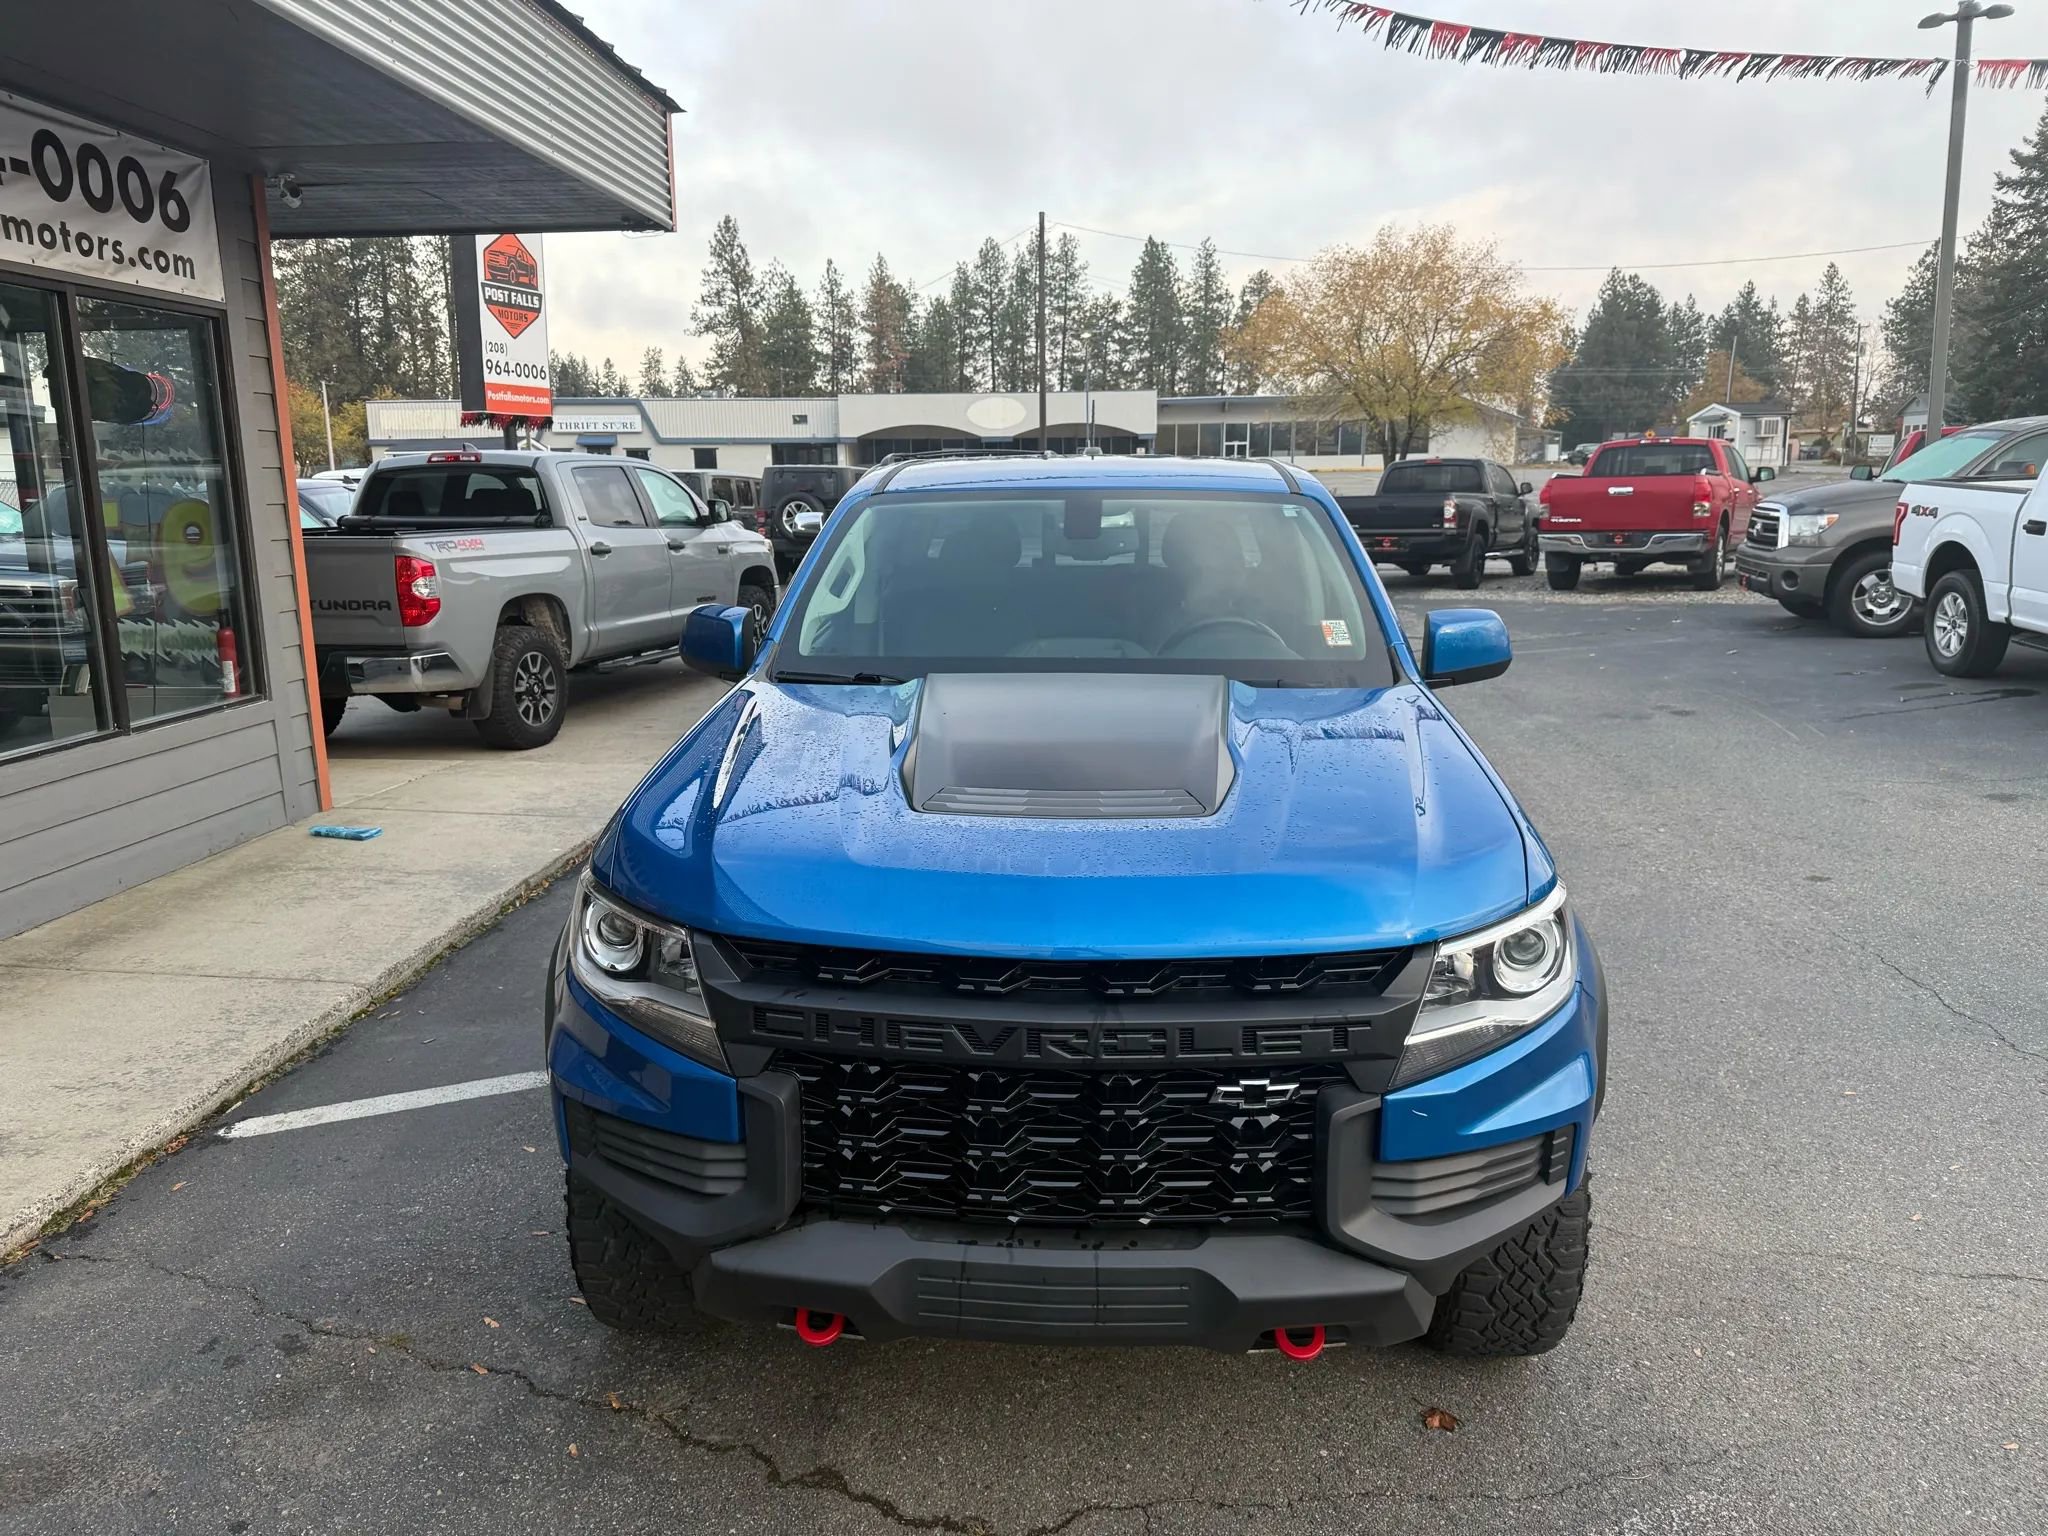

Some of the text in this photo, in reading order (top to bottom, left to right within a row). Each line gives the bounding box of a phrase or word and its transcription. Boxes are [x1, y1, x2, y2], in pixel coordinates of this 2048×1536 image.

[0, 128, 190, 233] -0006
[484, 286, 540, 308] POST FALLS
[498, 308, 529, 323] MOTORS
[485, 340, 508, 356] (208)
[485, 358, 547, 380] 964-0006
[487, 390, 550, 404] Postfallsmotors.com
[558, 421, 599, 430] THRIFT
[424, 540, 457, 553] TRD
[751, 1006, 1373, 1058] CHEVROLET
